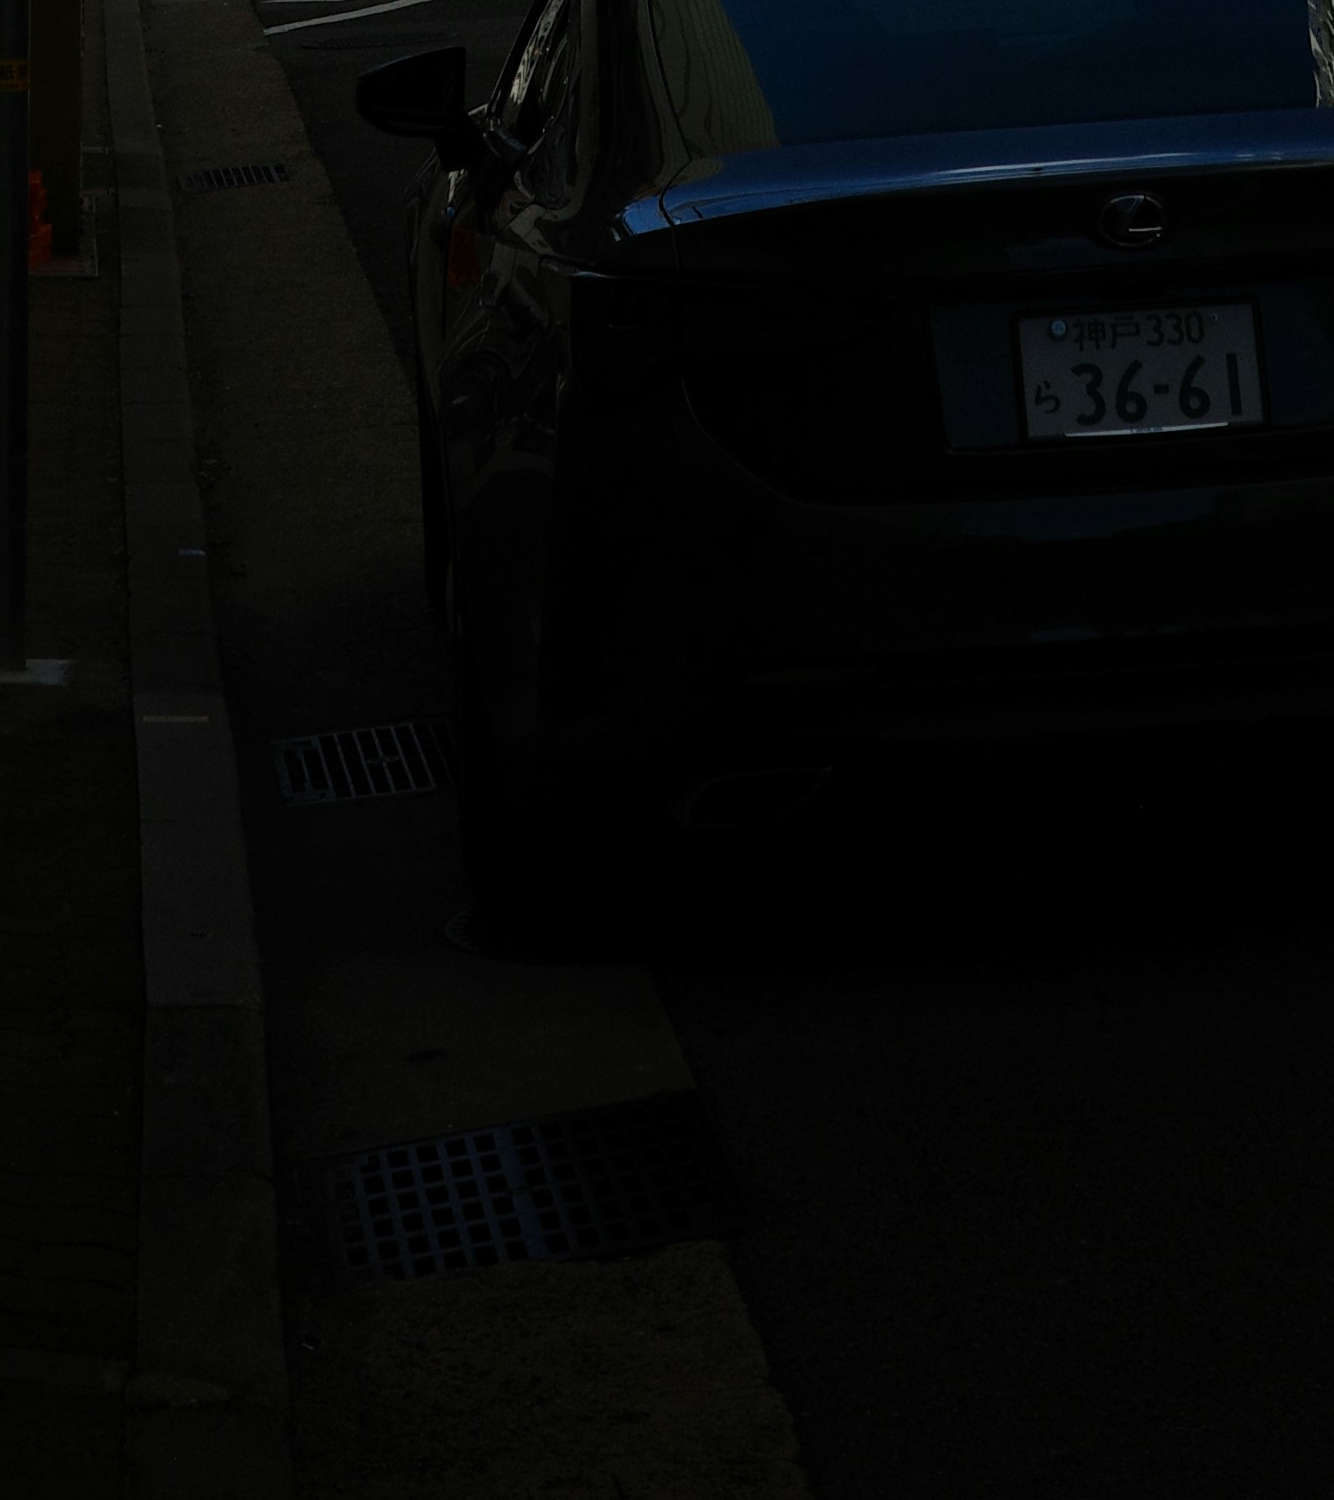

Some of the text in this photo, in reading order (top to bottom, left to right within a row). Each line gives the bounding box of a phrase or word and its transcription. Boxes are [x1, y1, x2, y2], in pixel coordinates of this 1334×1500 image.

[1146, 310, 1205, 348] 330
[1034, 352, 1243, 426] ら 36-61
